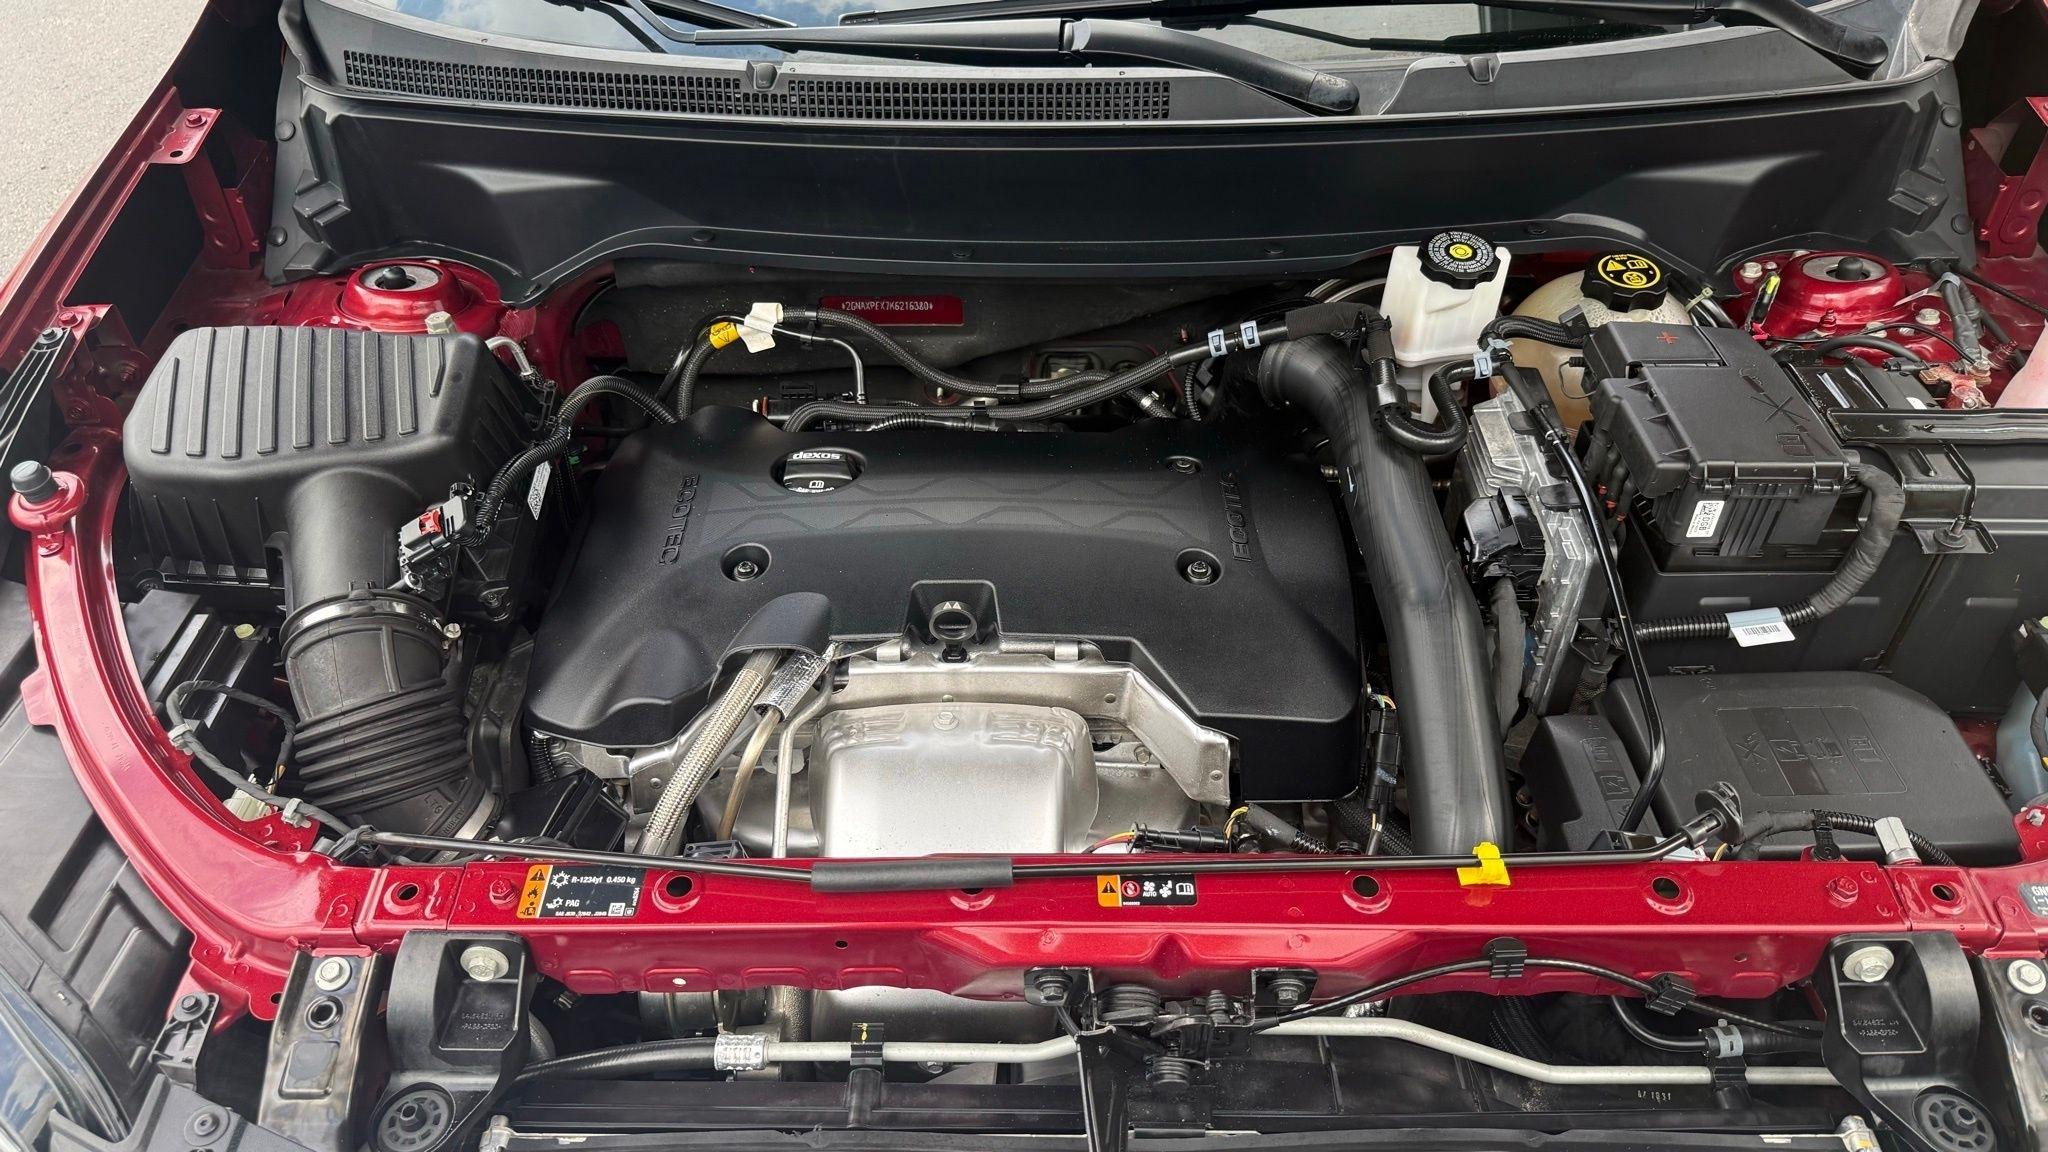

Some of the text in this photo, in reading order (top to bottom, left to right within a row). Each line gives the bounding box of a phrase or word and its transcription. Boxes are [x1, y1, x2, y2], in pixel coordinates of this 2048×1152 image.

[792, 451, 841, 460] dexos
[659, 474, 700, 566] ECOTEC
[571, 876, 637, 885] R-1234yf 0.450 kg
[565, 899, 580, 908] PAG
